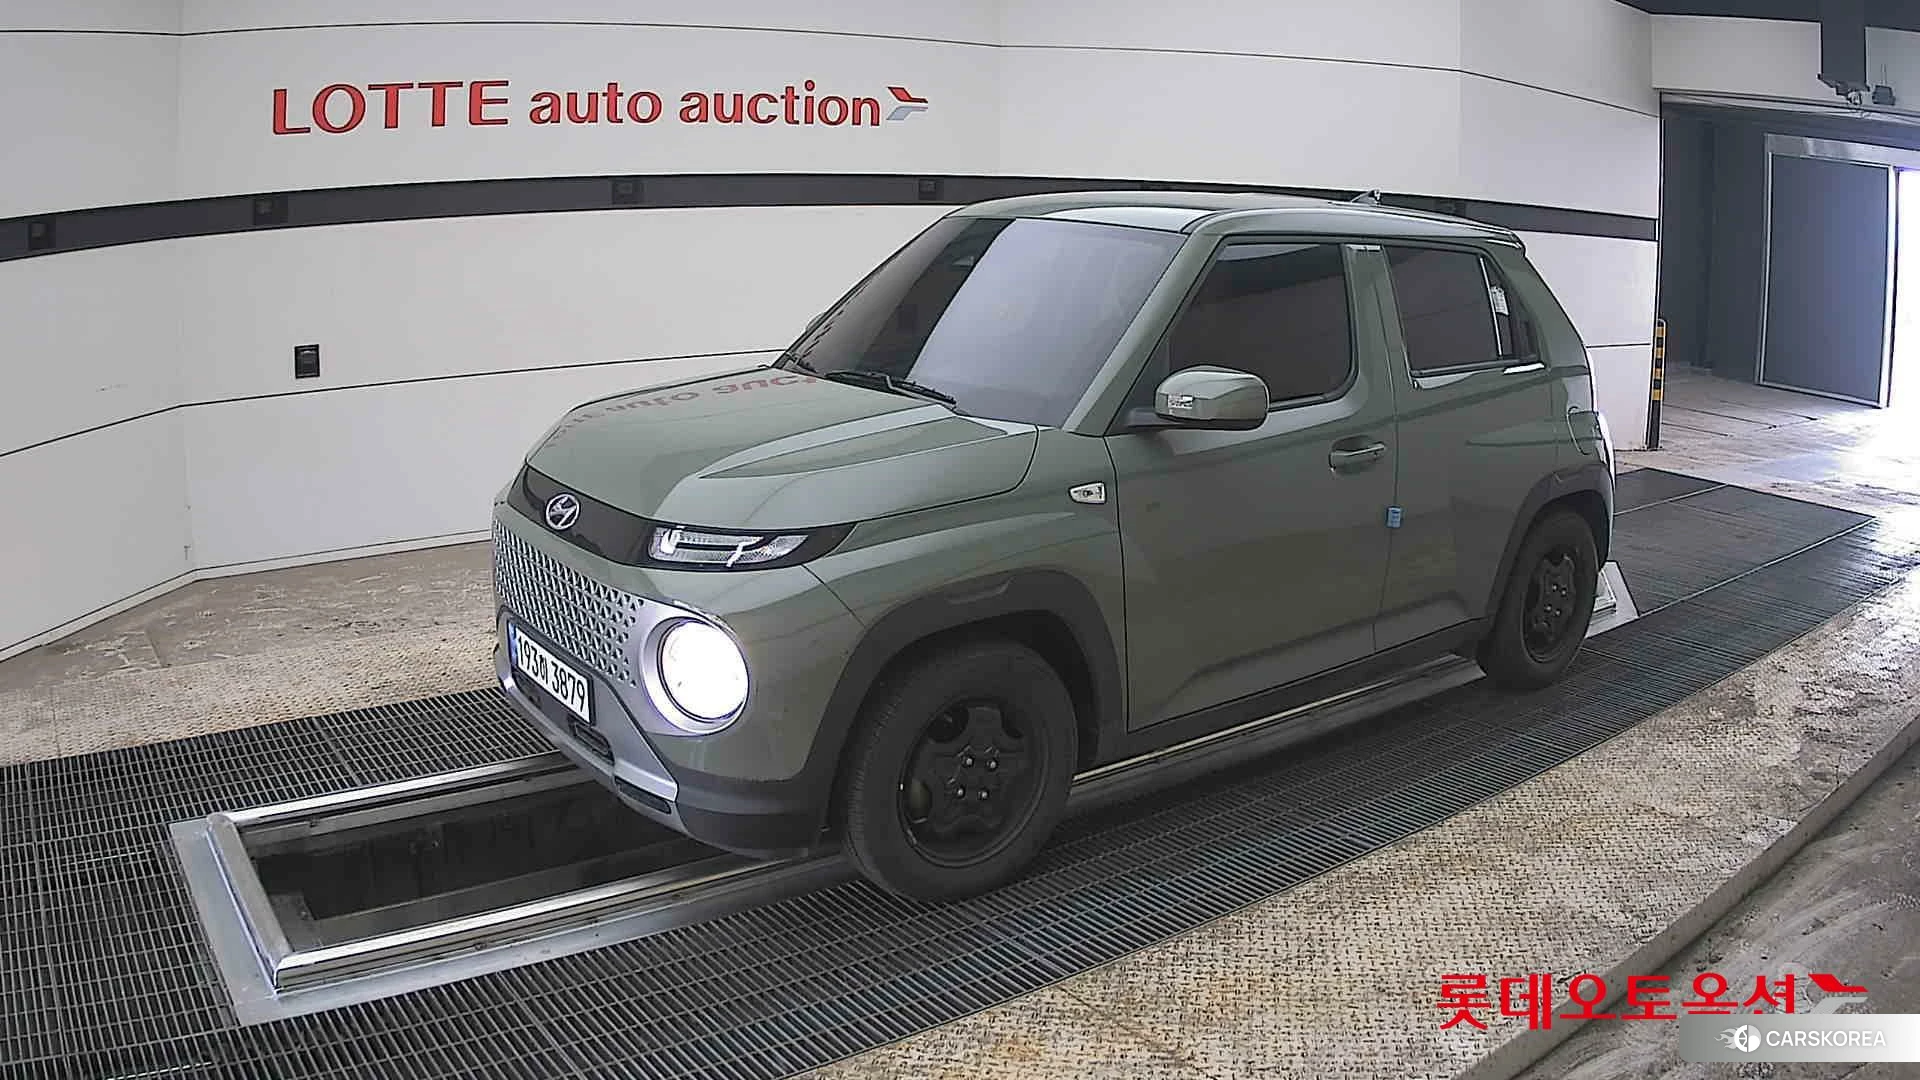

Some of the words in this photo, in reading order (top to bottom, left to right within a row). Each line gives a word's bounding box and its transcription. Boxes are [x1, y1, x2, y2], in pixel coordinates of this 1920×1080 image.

[272, 80, 509, 135] LOTTE
[529, 81, 662, 125] auto
[679, 79, 881, 127] auction
[551, 660, 585, 712] 3879
